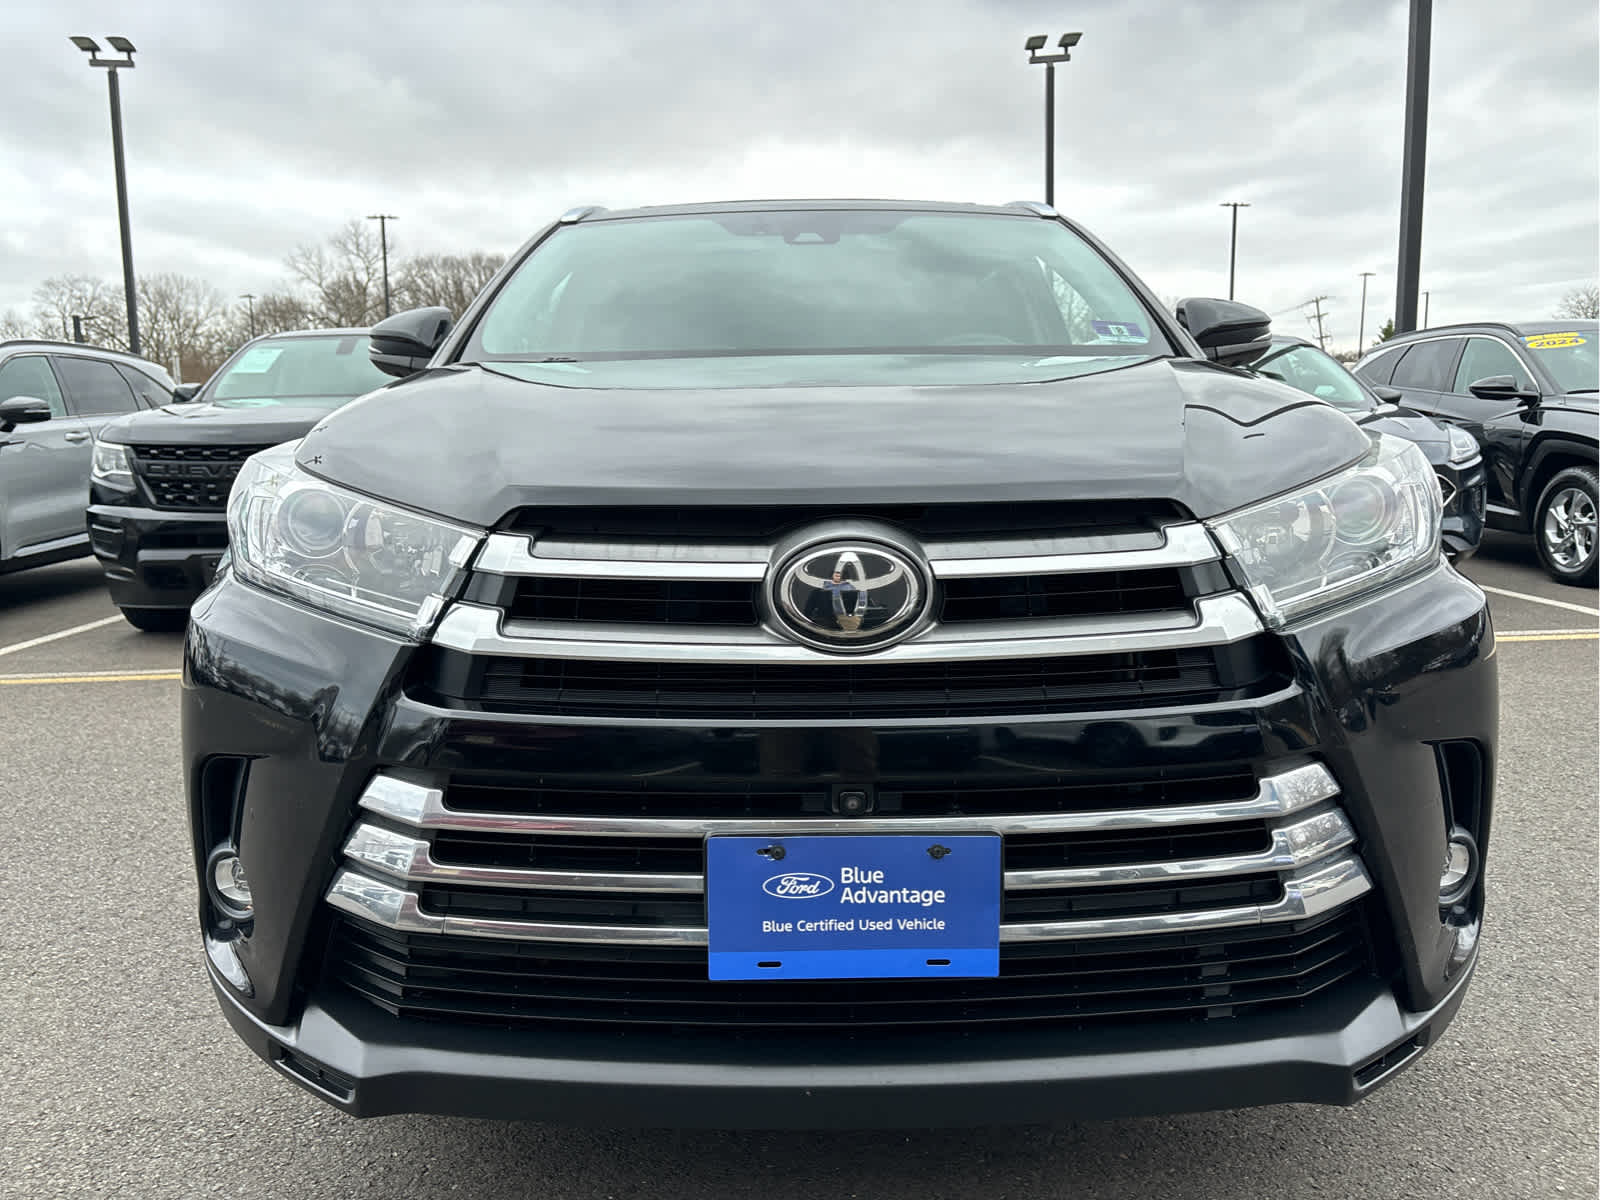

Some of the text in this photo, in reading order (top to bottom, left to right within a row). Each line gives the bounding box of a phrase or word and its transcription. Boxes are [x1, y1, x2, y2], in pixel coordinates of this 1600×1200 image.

[1536, 338, 1579, 348] 2024
[840, 867, 884, 884] Blue
[776, 876, 821, 895] Ford
[840, 887, 946, 907] Advantage
[762, 918, 946, 932] Blue Certified Used Vehicle
